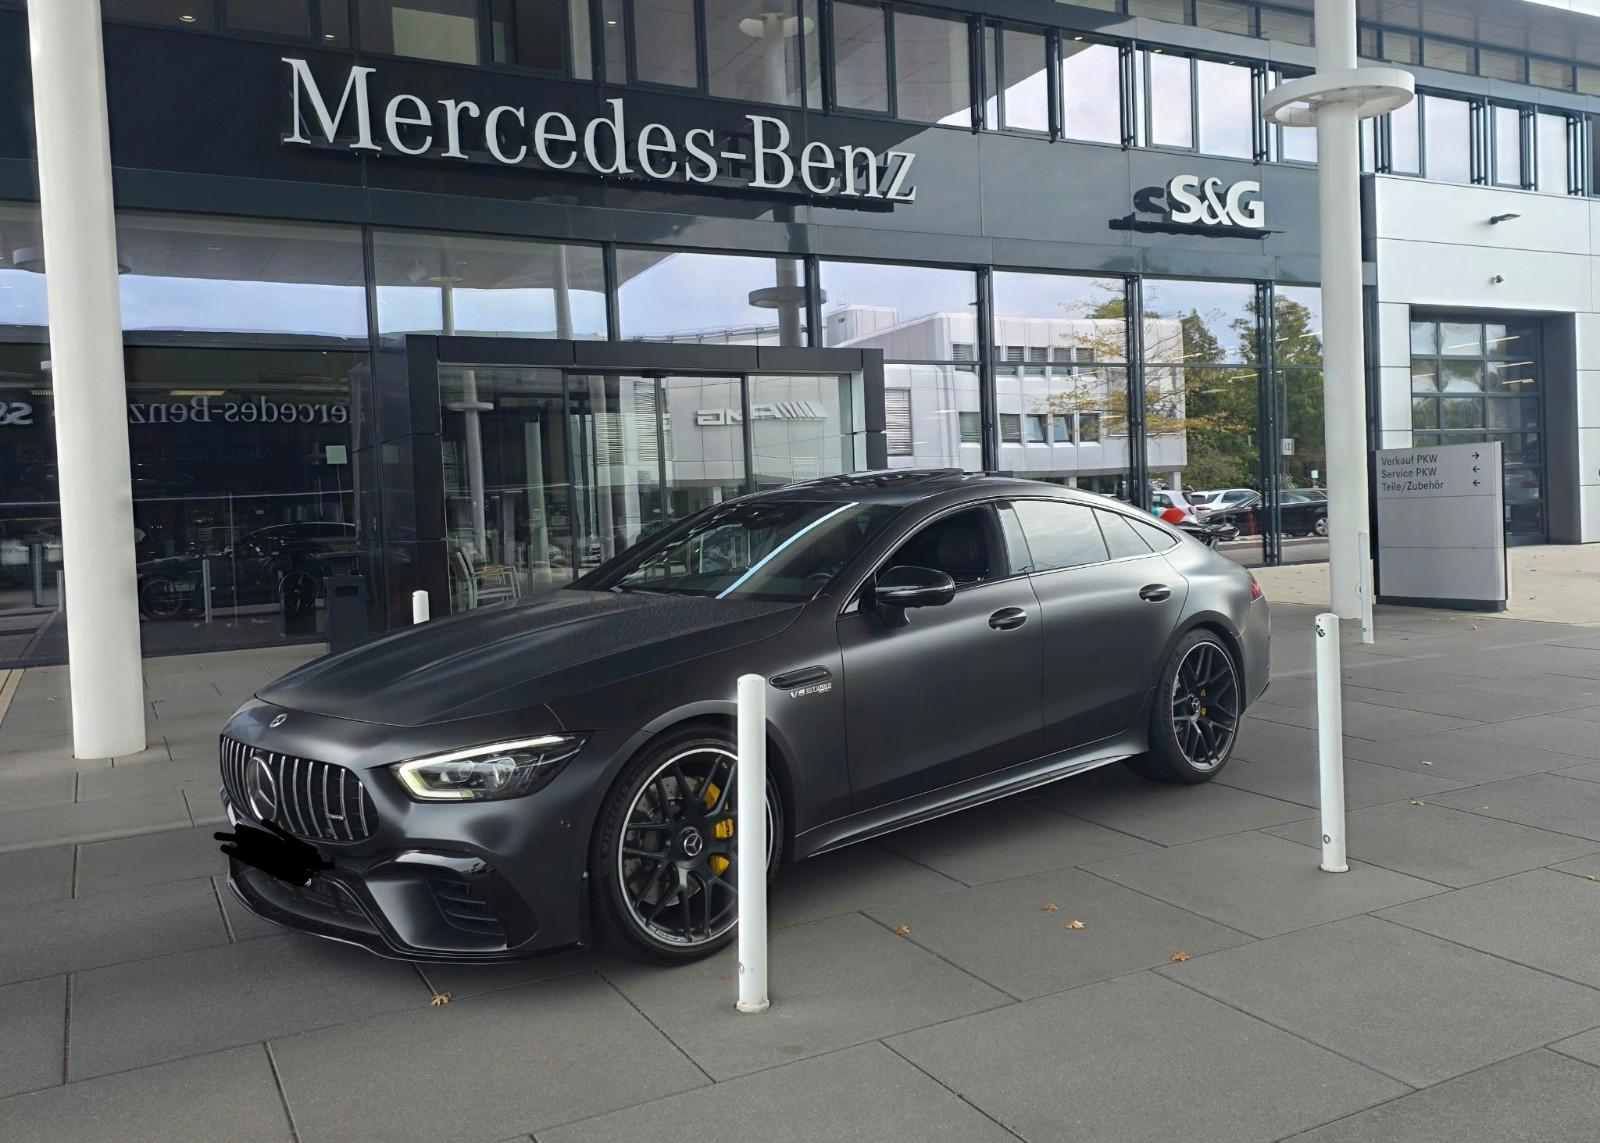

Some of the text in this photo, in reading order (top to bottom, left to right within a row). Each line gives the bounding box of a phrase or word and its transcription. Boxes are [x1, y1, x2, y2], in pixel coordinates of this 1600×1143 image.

[281, 57, 917, 203] Mercedes-Benz
[1170, 174, 1265, 228] S&G
[1381, 454, 1438, 466] Verkauf PKW
[1381, 467, 1437, 479] Service PKW
[1381, 480, 1444, 493] Teile/Zubehör
